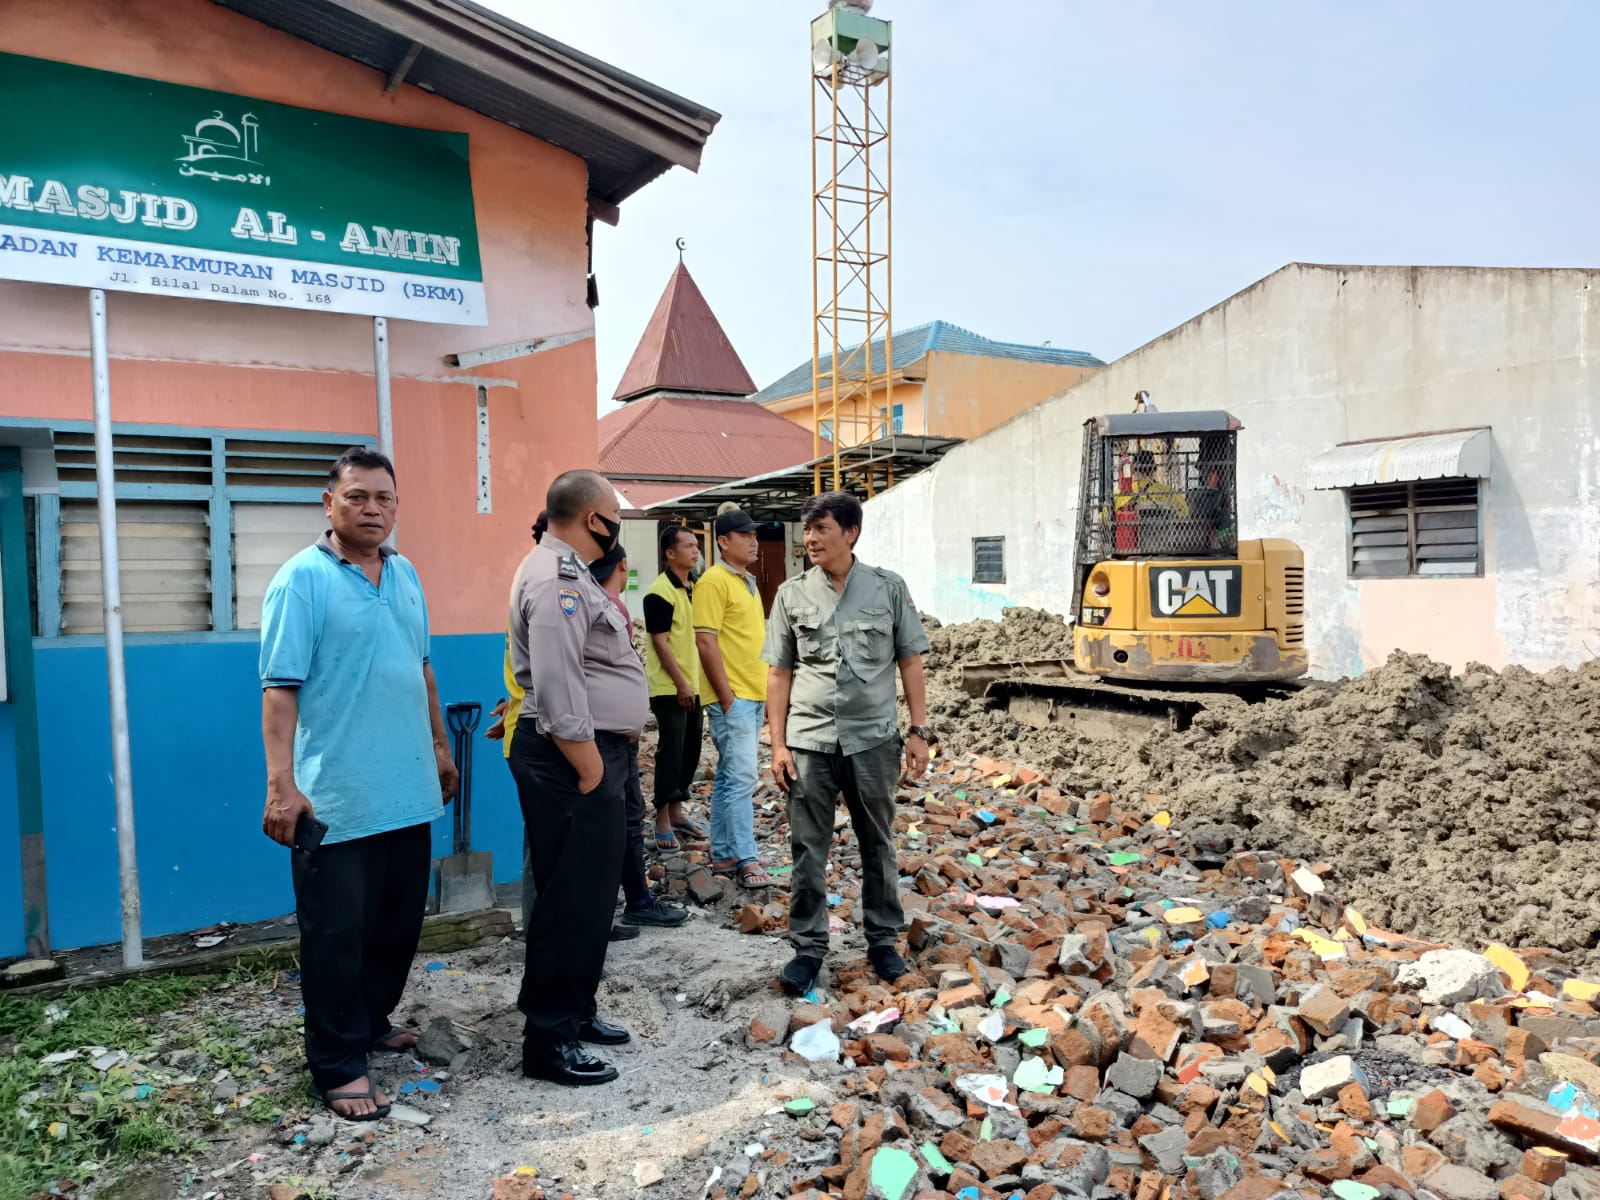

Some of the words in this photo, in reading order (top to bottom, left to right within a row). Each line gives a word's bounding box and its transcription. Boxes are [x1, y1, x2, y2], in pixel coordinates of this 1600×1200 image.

[0, 174, 198, 231] MASJID
[230, 207, 298, 245] AL
[339, 222, 461, 266] AMIN
[96, 245, 273, 281] KEMAKMURAN
[291, 268, 385, 293] MASJID
[402, 281, 465, 305] (BKM)
[109, 272, 139, 284] Jl.
[151, 276, 200, 291] Bilal
[210, 283, 260, 297] Dalam
[268, 289, 294, 301] No.
[306, 293, 332, 304] 168
[1157, 569, 1233, 615] CAT
